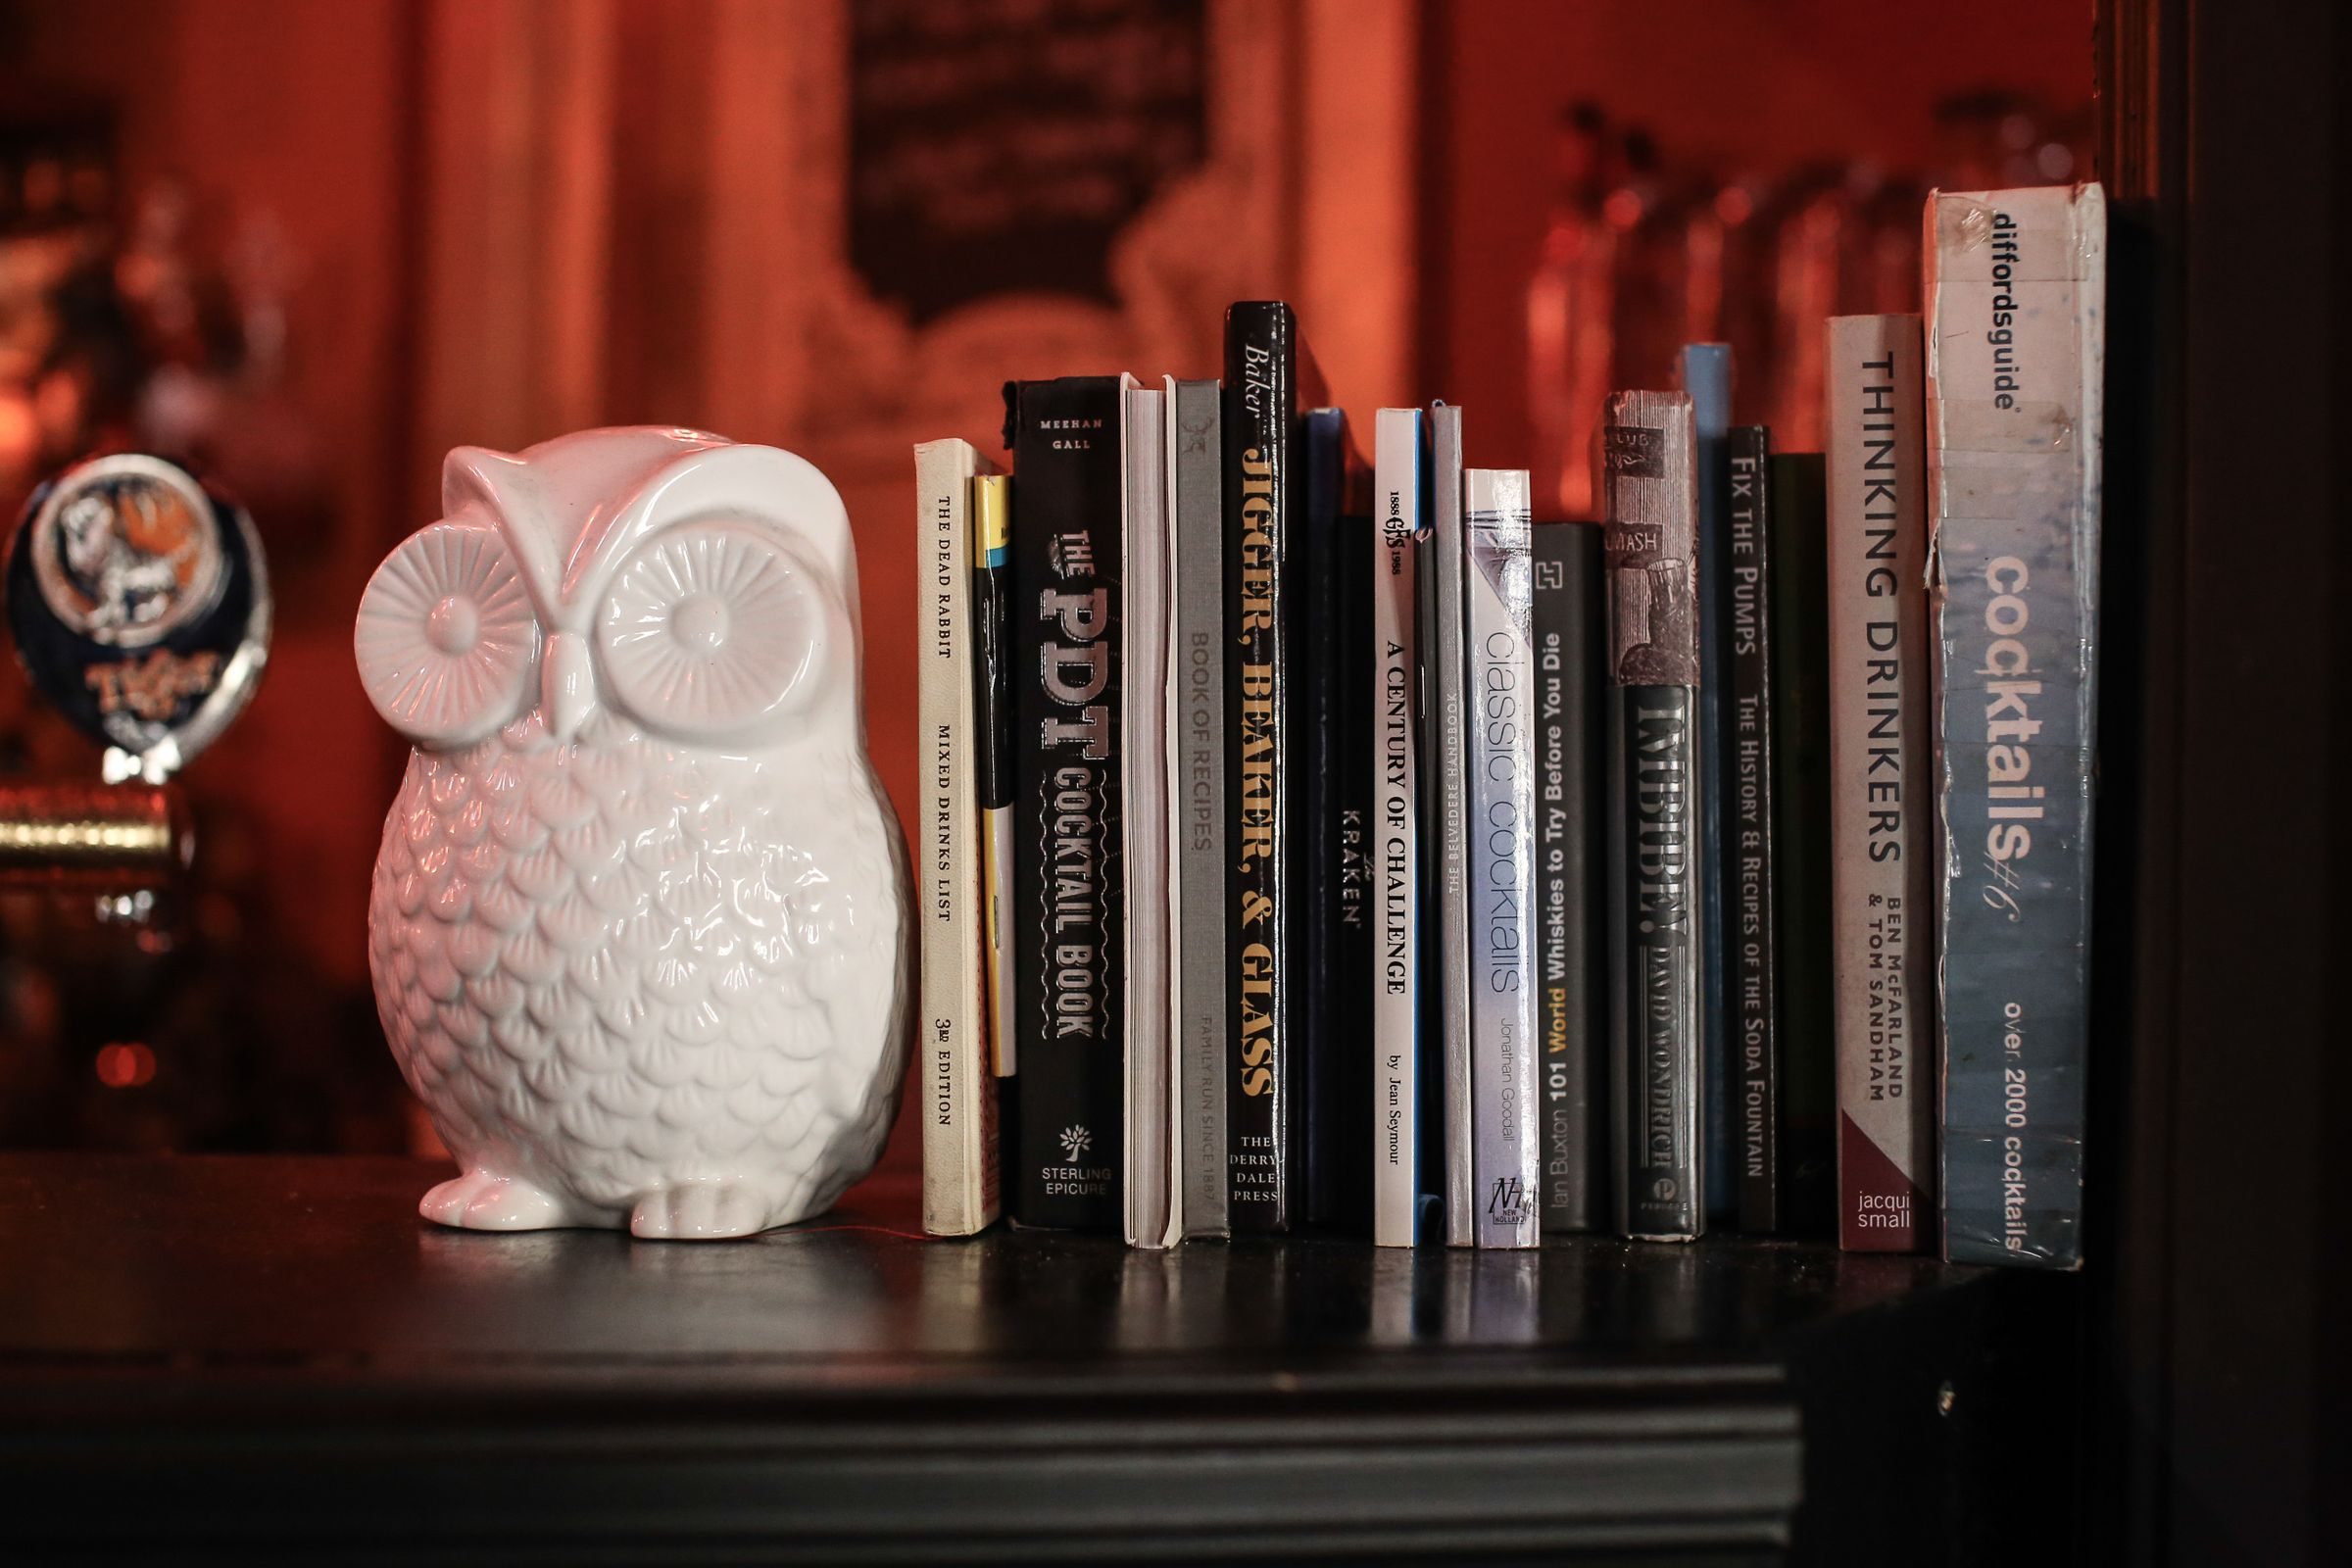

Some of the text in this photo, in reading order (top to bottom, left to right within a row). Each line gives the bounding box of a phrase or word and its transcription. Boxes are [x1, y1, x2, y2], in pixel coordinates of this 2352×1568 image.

[1040, 419, 1103, 429] MEEHAN
[1245, 344, 1270, 419] Baker
[1053, 440, 1091, 450] GALL
[1390, 491, 1399, 515] 1888
[1732, 458, 1759, 655] FIX THE PUMPS
[938, 496, 951, 660] THE DEAD RABBIT
[1392, 551, 1401, 575] 1988
[1862, 351, 1901, 862] THINKING DRINKERS
[1041, 529, 1108, 760] THE PDT
[1192, 631, 1211, 851] BOOK OF RECIPES
[1984, 556, 2045, 860] cocktails
[938, 724, 951, 921] MIXED DRINKS LIST
[1237, 447, 1274, 1098] JIGGER, BEAKER, & GLASS
[1387, 640, 1405, 995] A CENTURY OF CHALLENGE
[1446, 692, 1459, 895] THE BELVEDERE HANDBOOK
[1487, 632, 1525, 993] classic cocktails
[1054, 767, 1095, 1040] COCKTAIL BOOK
[1343, 809, 1360, 923] KRAKEN
[1543, 632, 1568, 1209] Ian Buxton 101 World Whiskies to Try Before You Die
[1887, 898, 1900, 944] BEN
[1649, 945, 1672, 1021] DAVID
[1740, 694, 1765, 1178] THE HISTORY & RECIPES OF THE SODA FOUNTAIN
[1869, 893, 1884, 1102] & TOM SANDHAM
[939, 1051, 951, 1126] EDITION
[1200, 1016, 1215, 1200] FAMILY RUN SINCE 1887
[1387, 1055, 1400, 1165] by Jean Seymour
[1500, 1018, 1515, 1142] Jonathan Goodall
[2005, 1068, 2027, 1128] 2000
[1042, 1168, 1111, 1180] STERLING
[1046, 1184, 1107, 1195] EPICURE
[1230, 1154, 1276, 1165] DERRY
[1233, 1190, 1278, 1201] PRESS
[1237, 1172, 1275, 1184] DALE
[1240, 1137, 1271, 1147] THE
[2004, 1137, 2028, 1251] cocktails
[1858, 1191, 1910, 1211] jacqui
[1858, 1211, 1910, 1229] small
